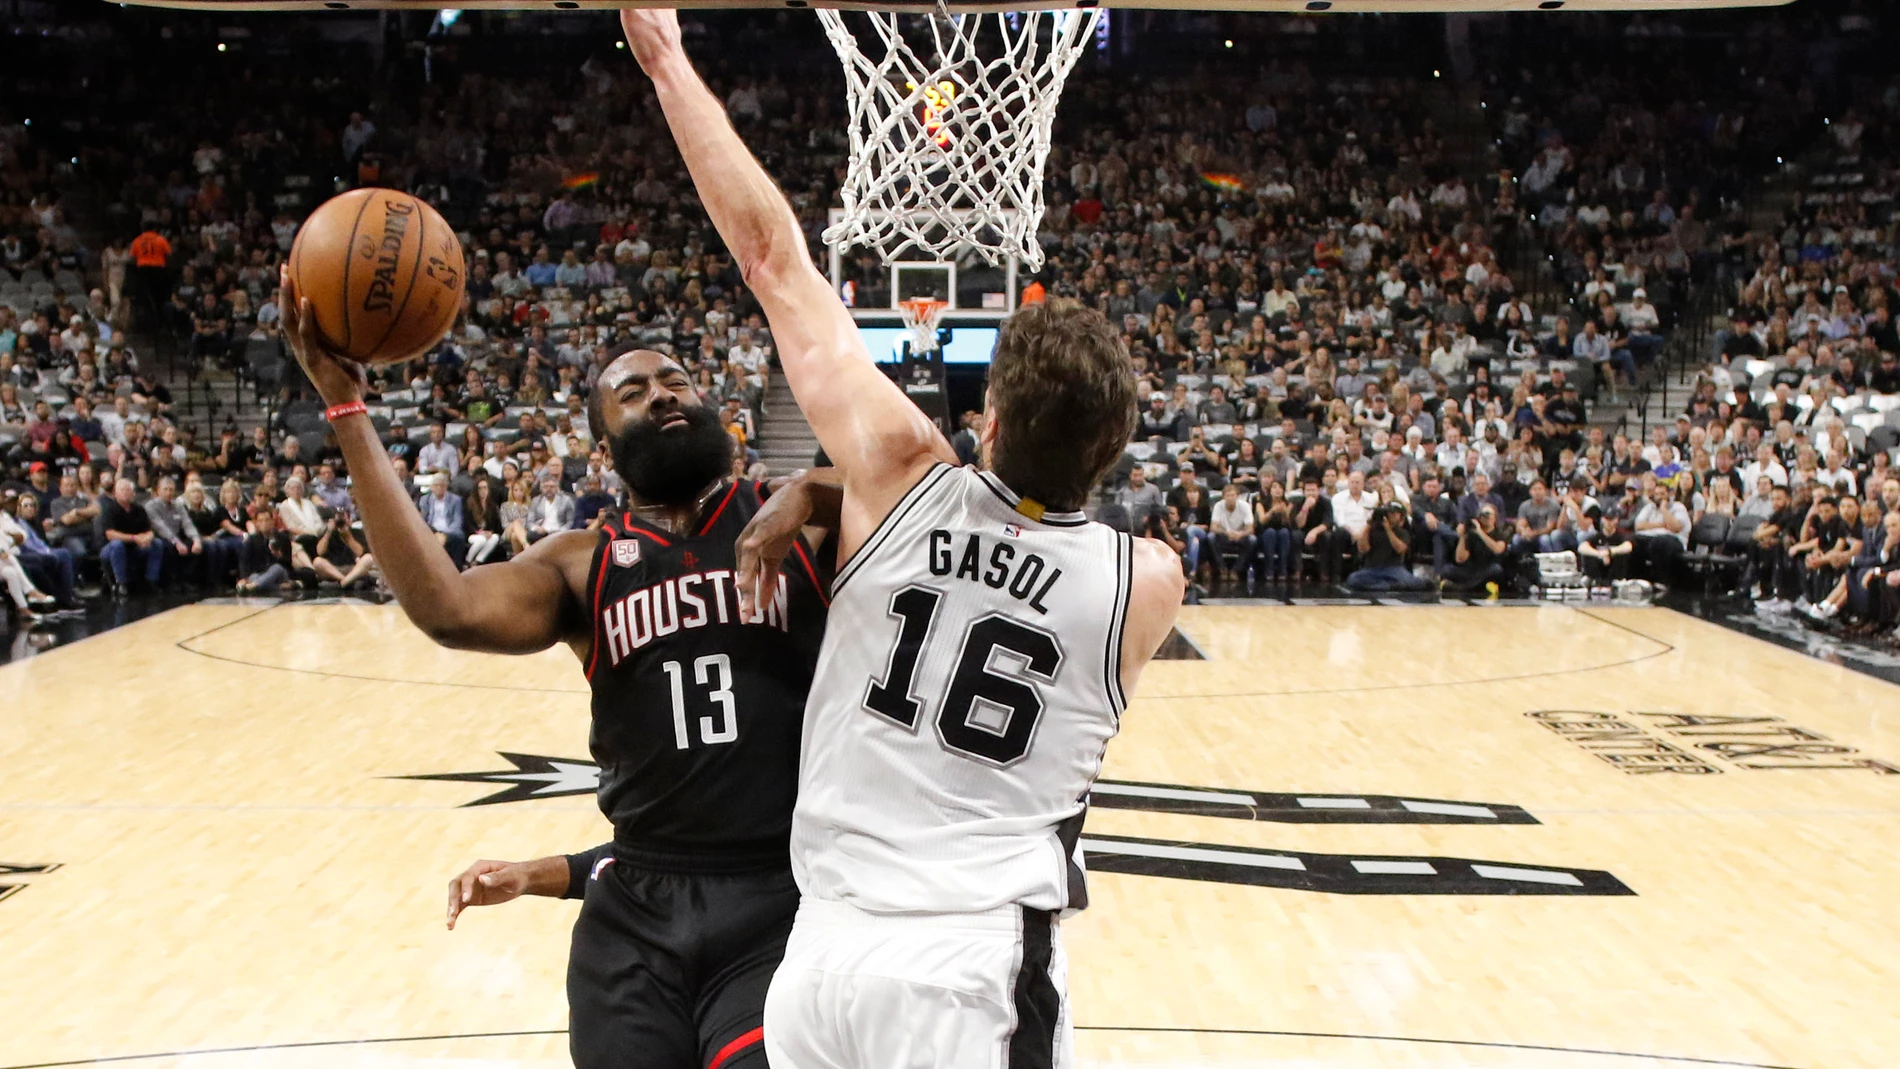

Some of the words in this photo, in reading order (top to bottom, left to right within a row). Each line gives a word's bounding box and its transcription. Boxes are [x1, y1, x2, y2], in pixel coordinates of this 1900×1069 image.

[363, 200, 414, 316] SPALDING
[618, 543, 637, 556] 50
[929, 529, 1062, 615] GASOL
[662, 653, 738, 750] 13
[861, 582, 1068, 771] 16
[1524, 710, 1724, 775] CENTER
